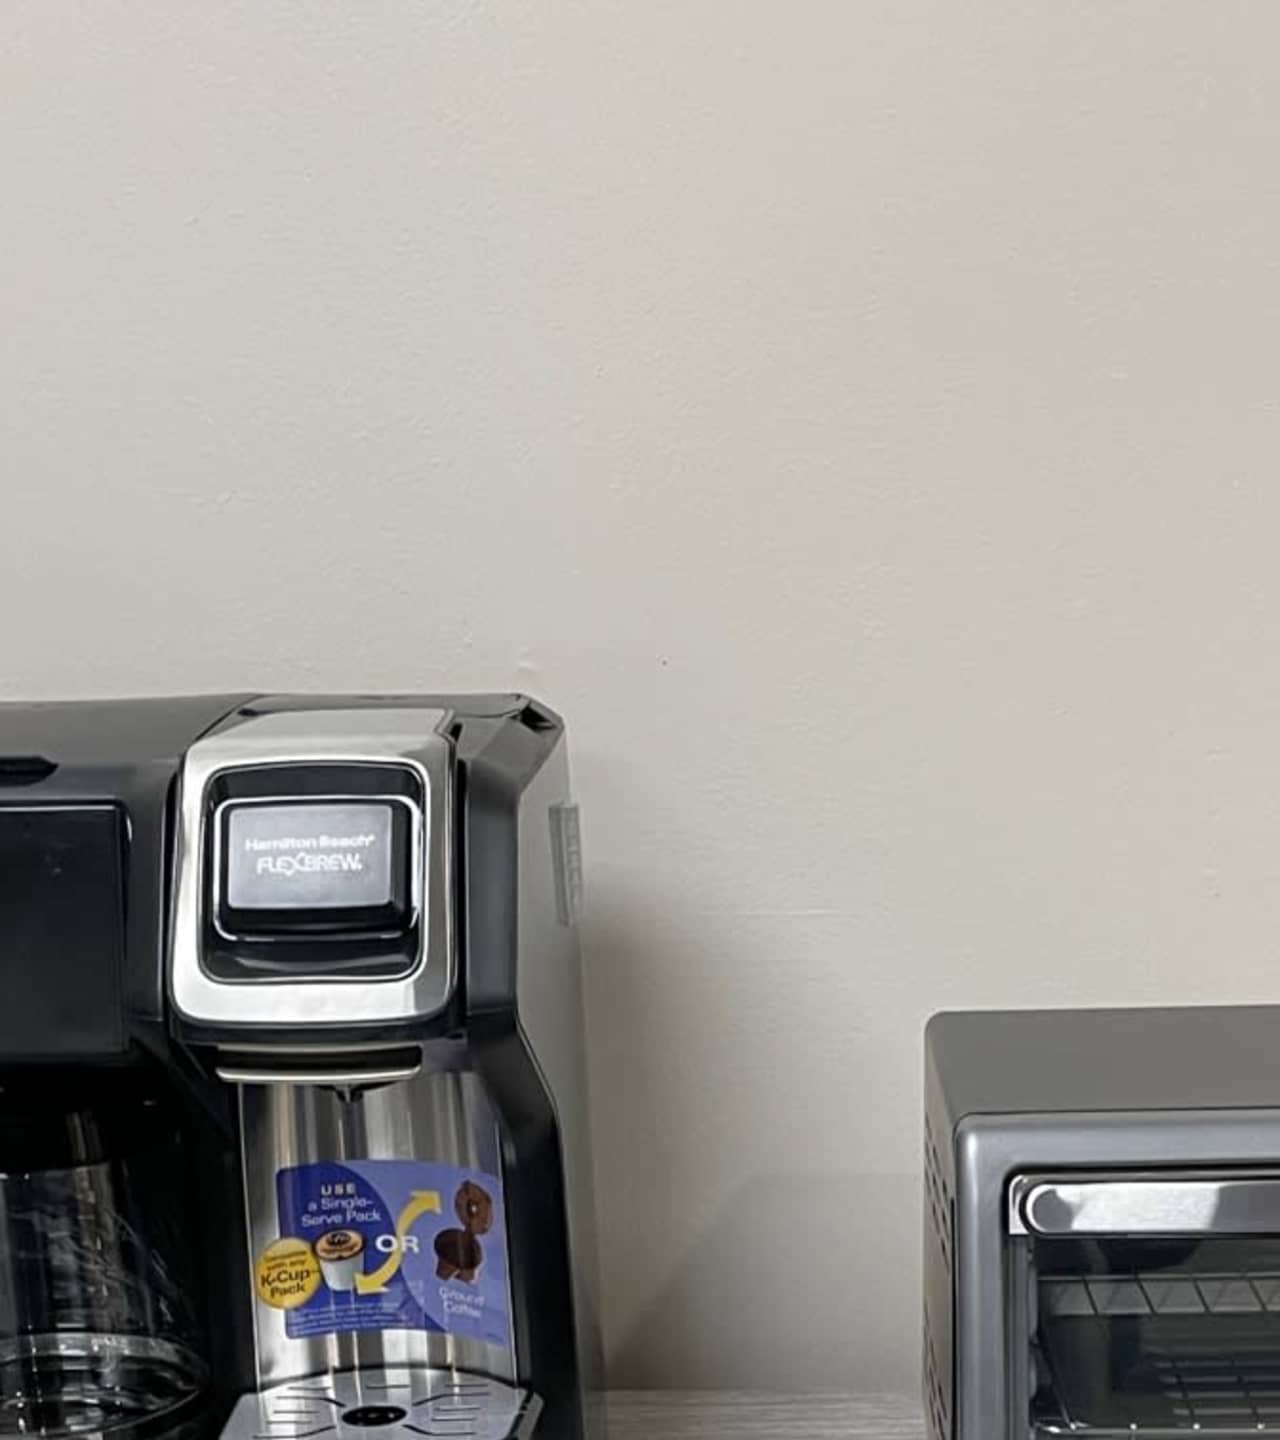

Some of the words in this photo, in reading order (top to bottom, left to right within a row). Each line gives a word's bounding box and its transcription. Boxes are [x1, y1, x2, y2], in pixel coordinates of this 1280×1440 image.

[244, 837, 317, 851] Hamilton
[320, 1183, 356, 1196] USE
[301, 1213, 343, 1228] Serve
[346, 1208, 381, 1222] Pack
[375, 1234, 419, 1254] OR
[270, 1282, 307, 1299] Pack
